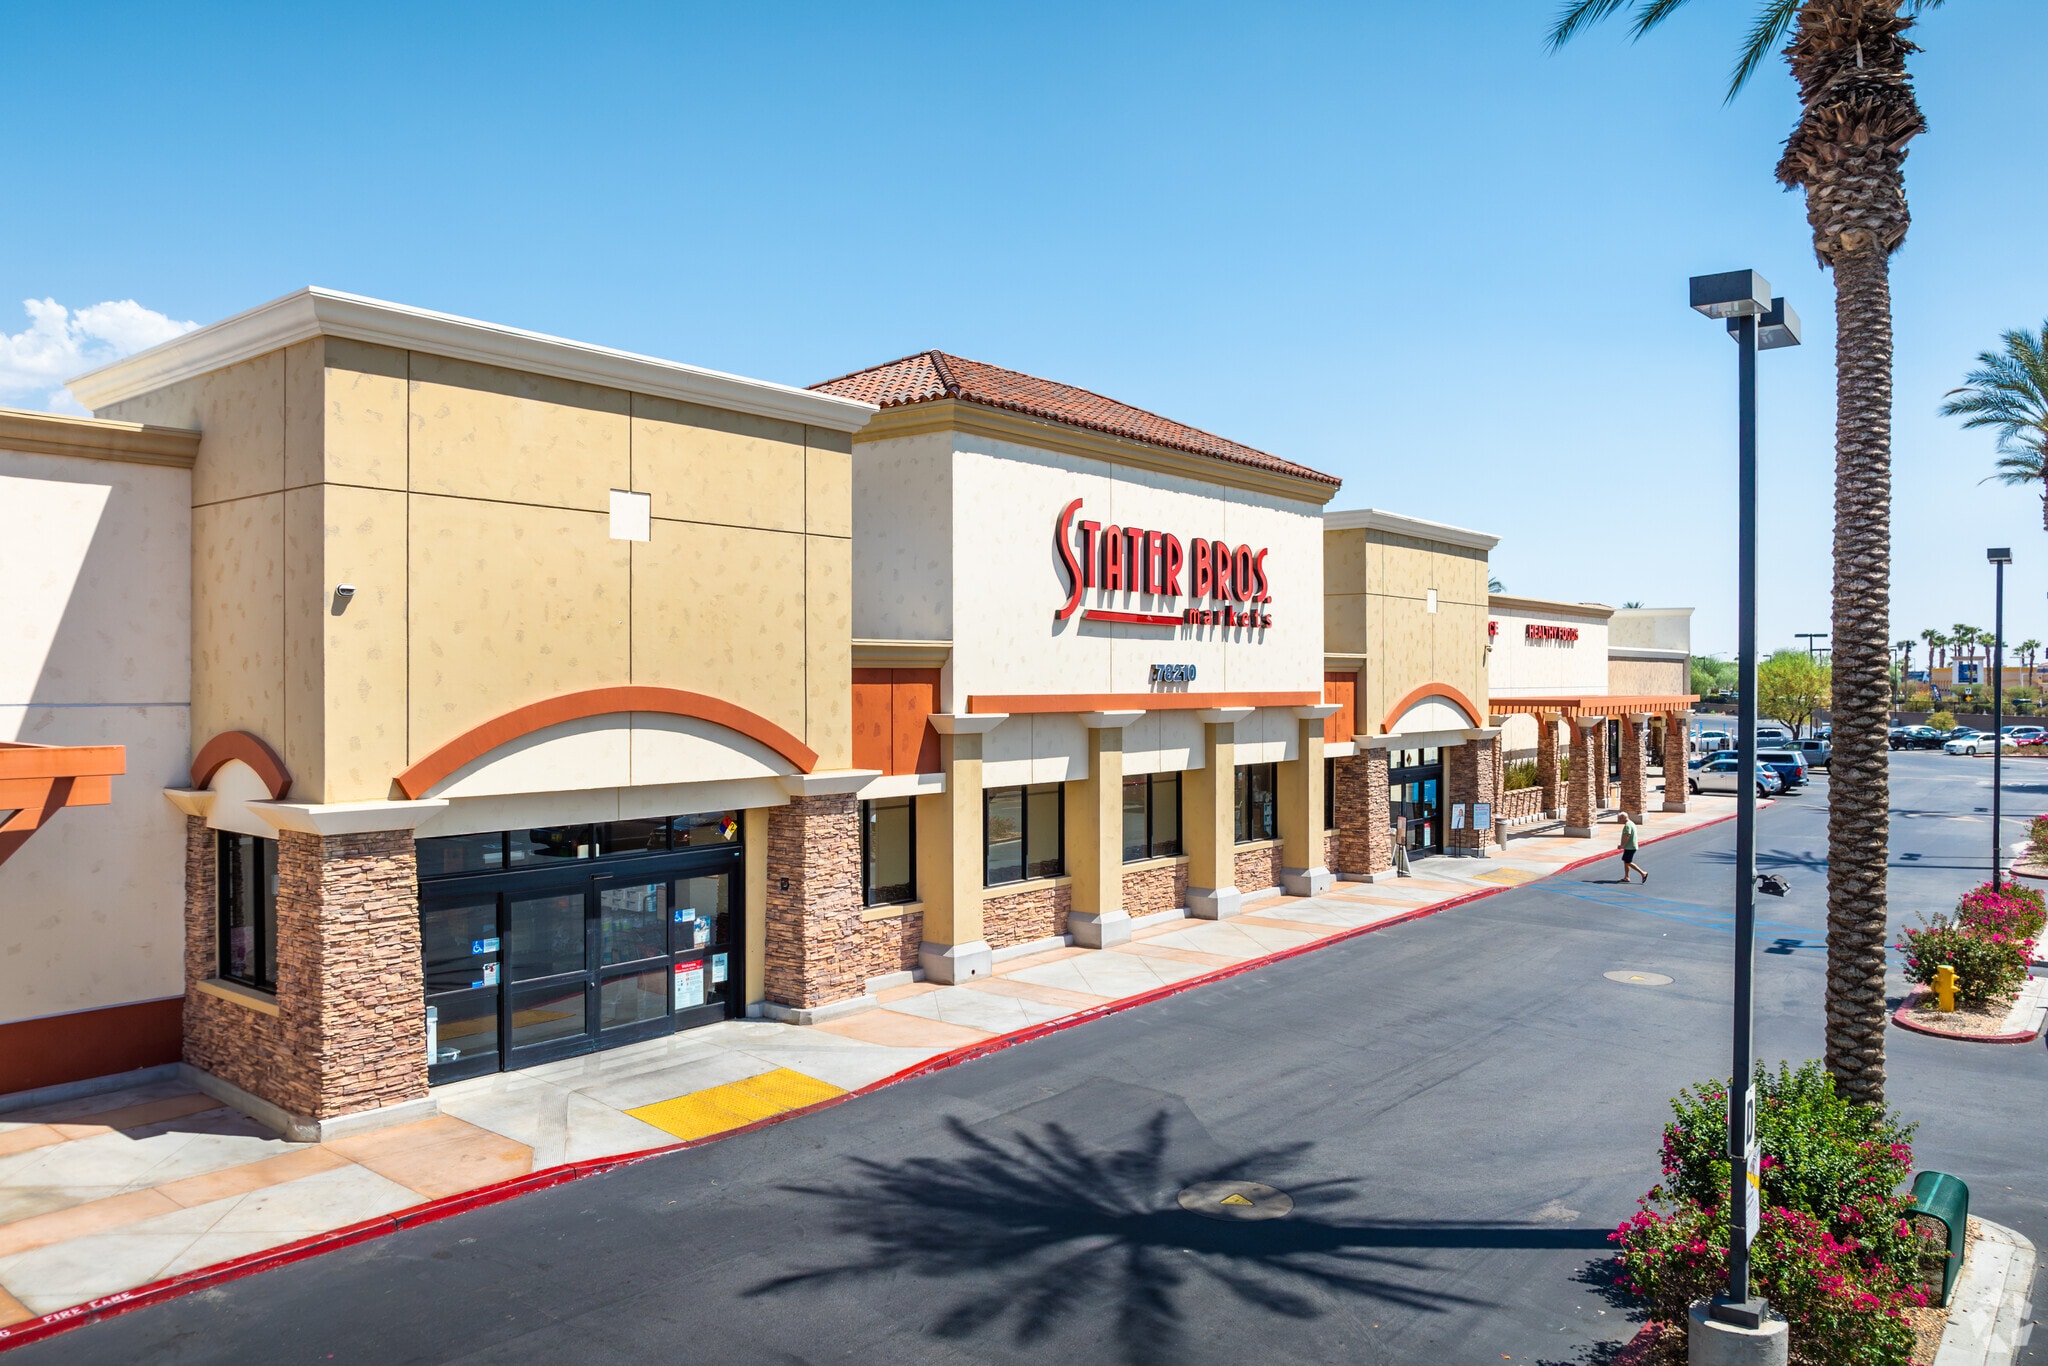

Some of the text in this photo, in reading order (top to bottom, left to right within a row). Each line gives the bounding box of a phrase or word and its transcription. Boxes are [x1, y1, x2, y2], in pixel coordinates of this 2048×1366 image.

[1055, 498, 1183, 620] STATER
[1184, 605, 1272, 629] markets
[1526, 624, 1579, 641] HEALTHY FOODS
[1153, 664, 1197, 682] 78210
[1747, 1099, 1753, 1145] D
[43, 1306, 83, 1323] FIRE
